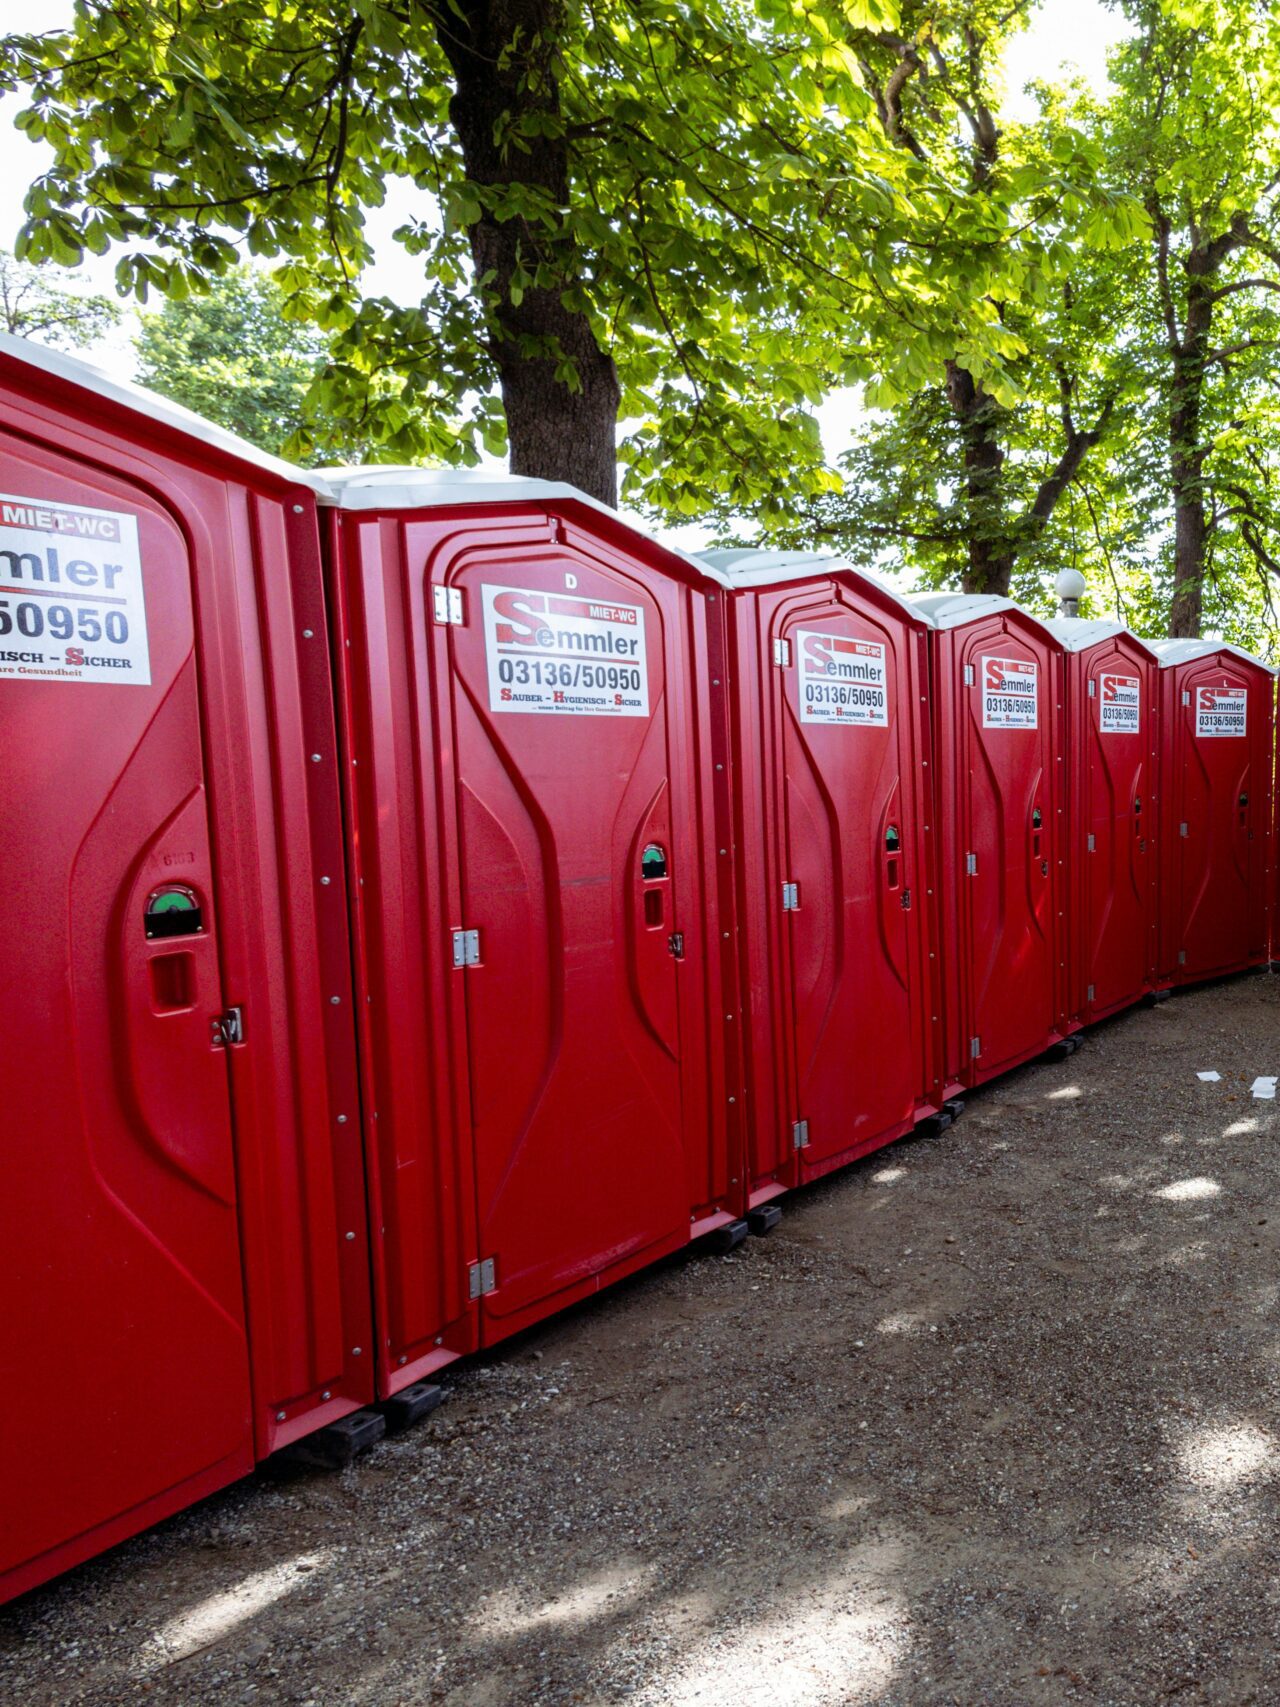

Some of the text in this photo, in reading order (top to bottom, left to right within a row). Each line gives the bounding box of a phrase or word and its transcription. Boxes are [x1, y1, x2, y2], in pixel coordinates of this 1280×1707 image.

[3, 505, 115, 538] MIET-WC
[564, 573, 578, 589] D
[493, 591, 638, 656] Semmler
[589, 605, 636, 623] MIET-WC
[65, 647, 132, 669] SICHER
[803, 635, 882, 681] Semmler
[18, 666, 82, 677] Gesundheit
[498, 658, 641, 691] 03136/50950
[986, 659, 1034, 693] Semmler
[500, 688, 543, 703] SAUBER
[553, 690, 606, 705] HYGIENISCH
[614, 694, 642, 706] SICHER
[805, 684, 883, 707] 03136/50950
[986, 698, 1035, 714] 03136/50950
[1200, 689, 1244, 711] Semmler
[1199, 716, 1244, 726] 03136/50950
